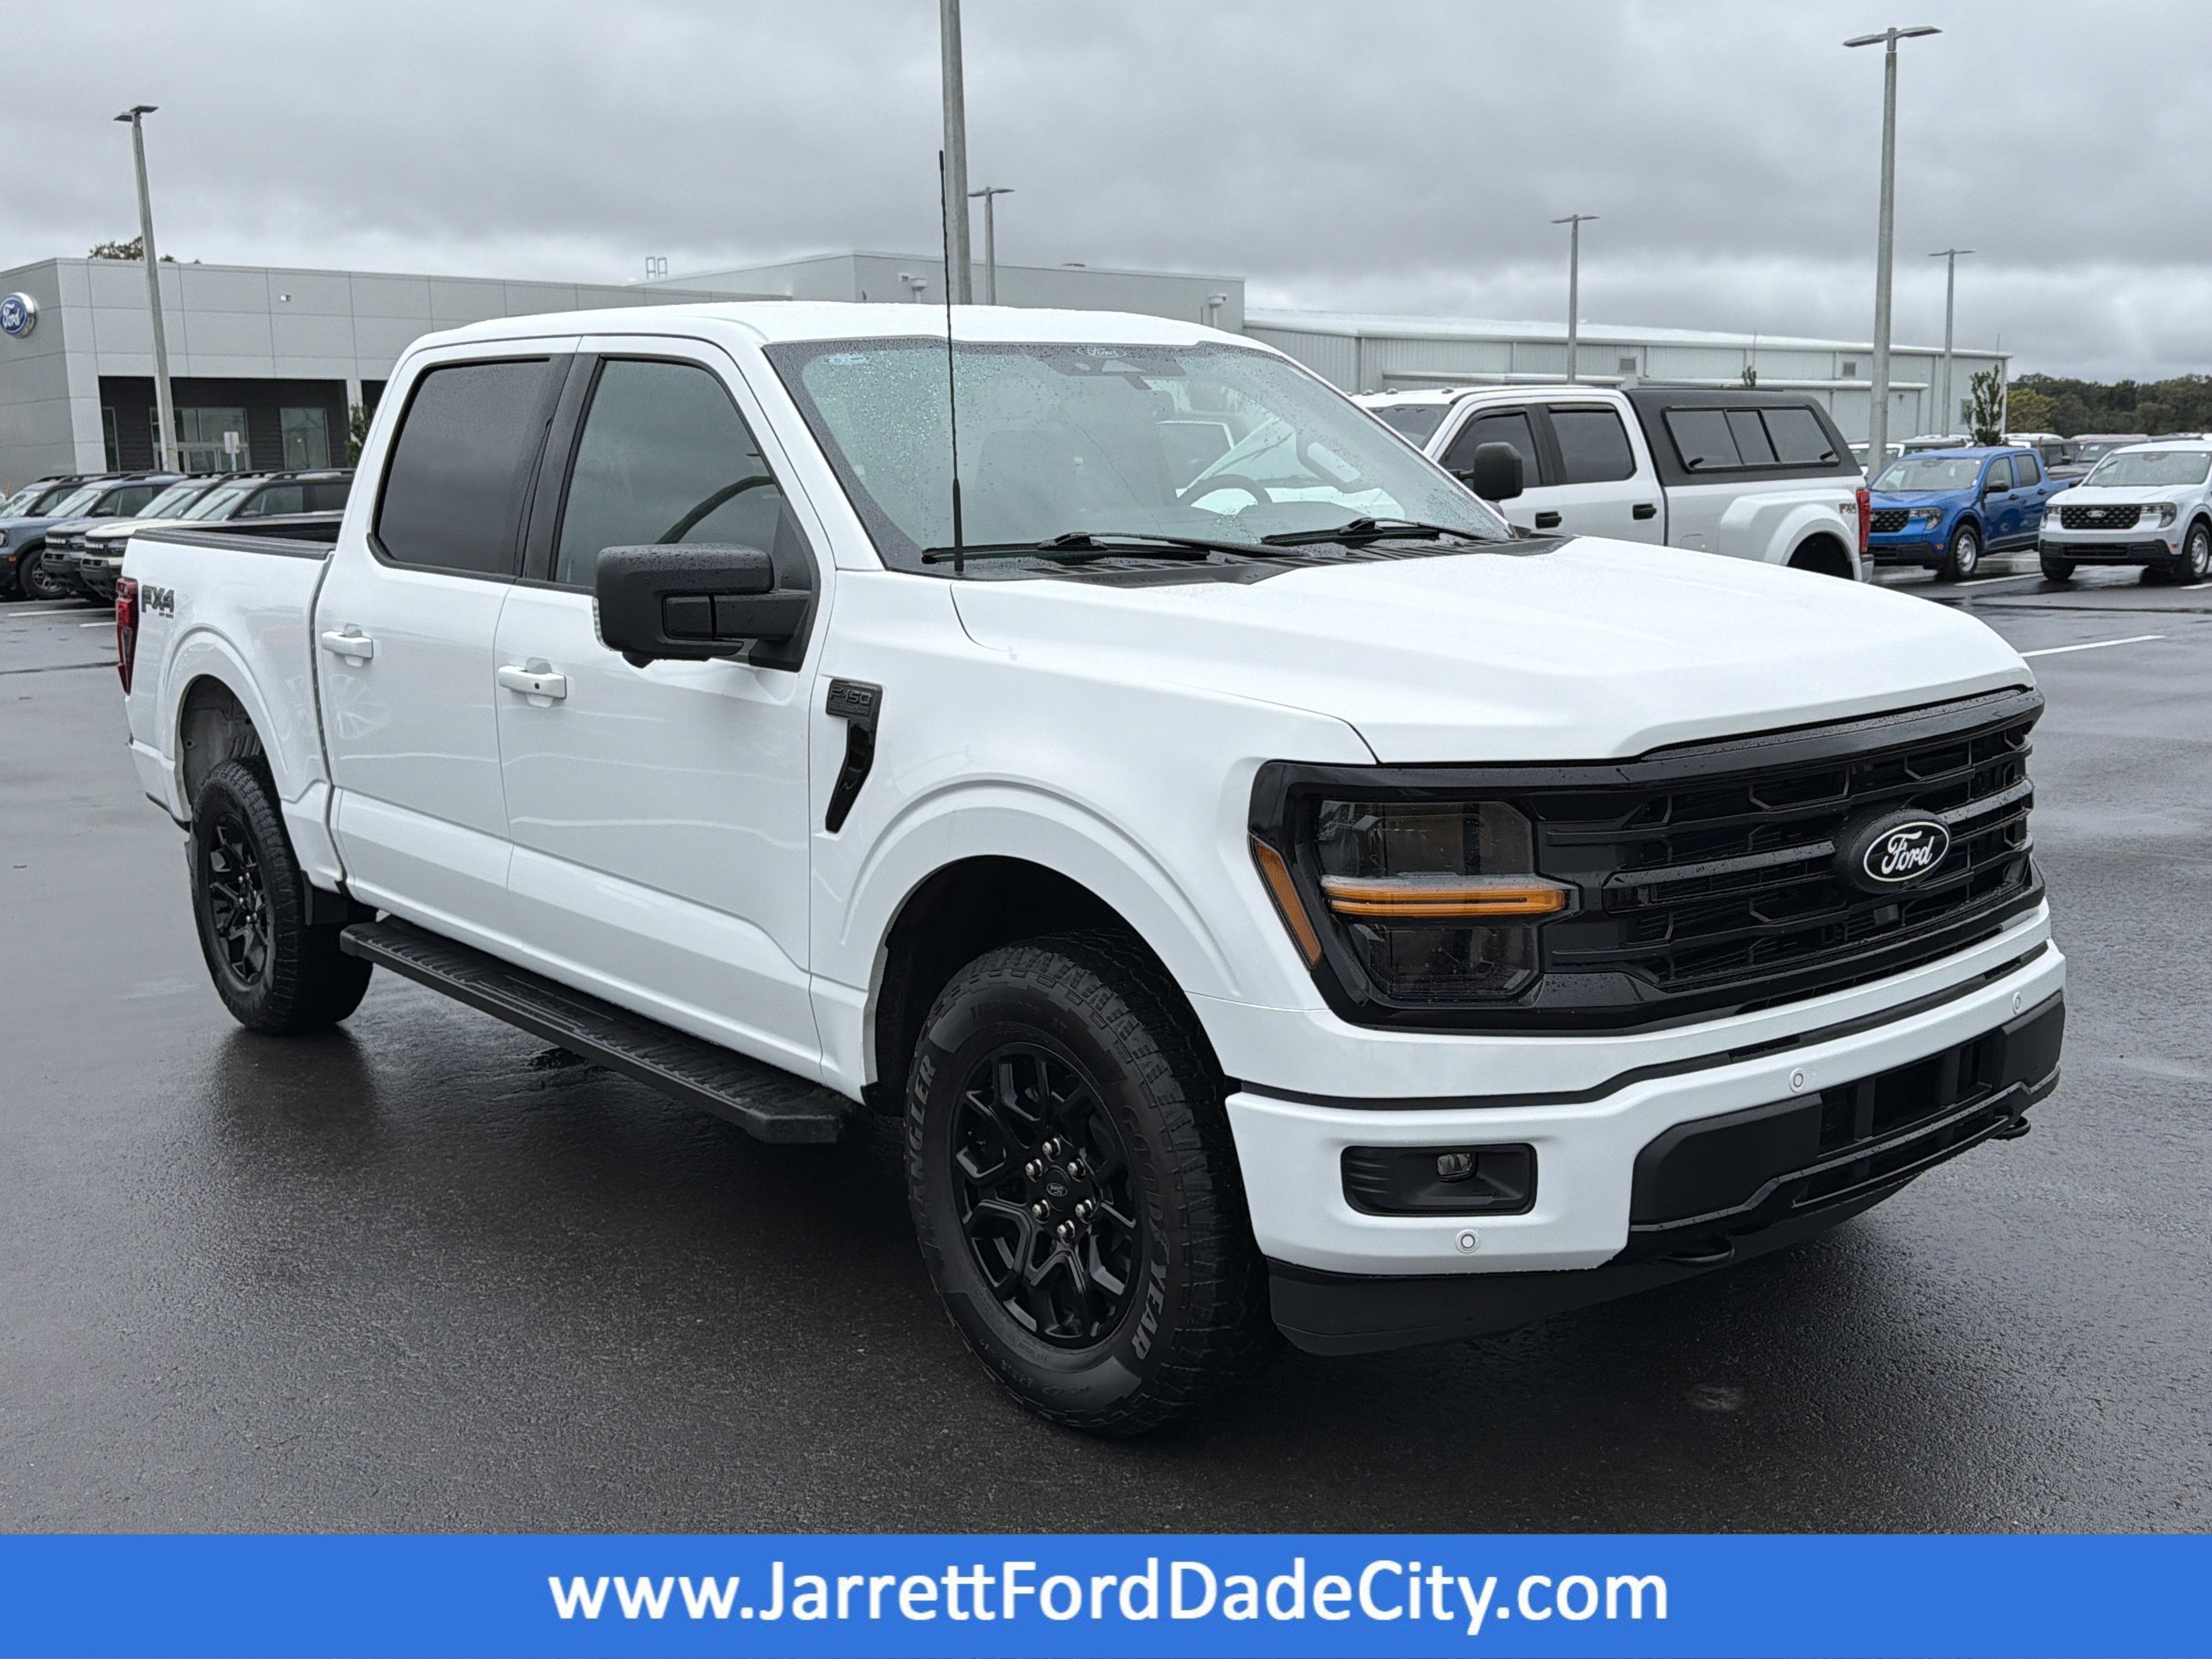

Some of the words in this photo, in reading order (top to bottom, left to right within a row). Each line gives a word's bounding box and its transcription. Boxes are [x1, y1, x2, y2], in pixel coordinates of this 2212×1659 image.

[2, 302, 20, 328] Ford
[141, 584, 174, 613] FX4
[1881, 830, 1936, 875] Ford
